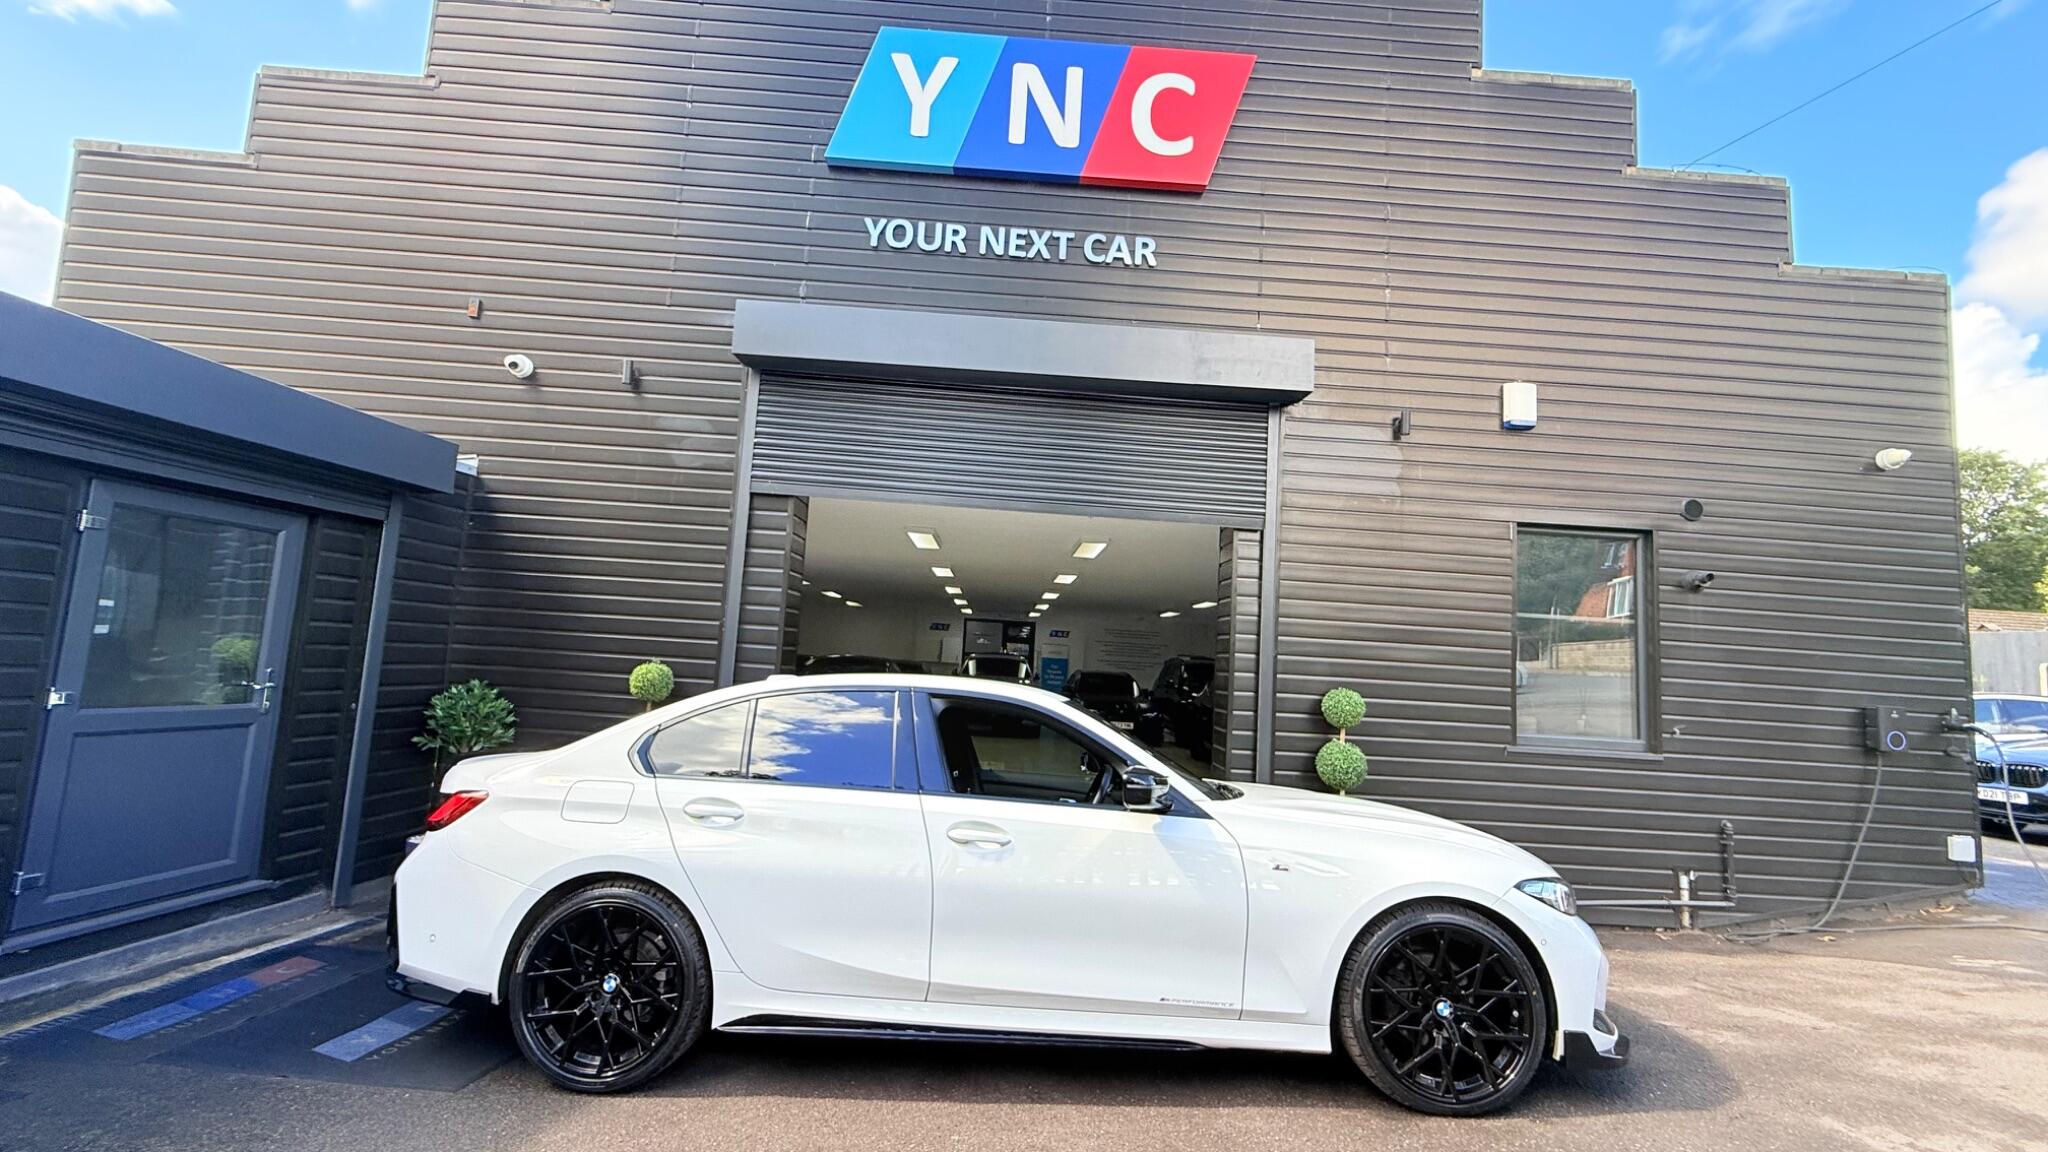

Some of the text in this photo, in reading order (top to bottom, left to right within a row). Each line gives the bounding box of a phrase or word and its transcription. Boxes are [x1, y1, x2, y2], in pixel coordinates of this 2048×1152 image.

[864, 217, 1158, 267] YOUR NEXT CAR
